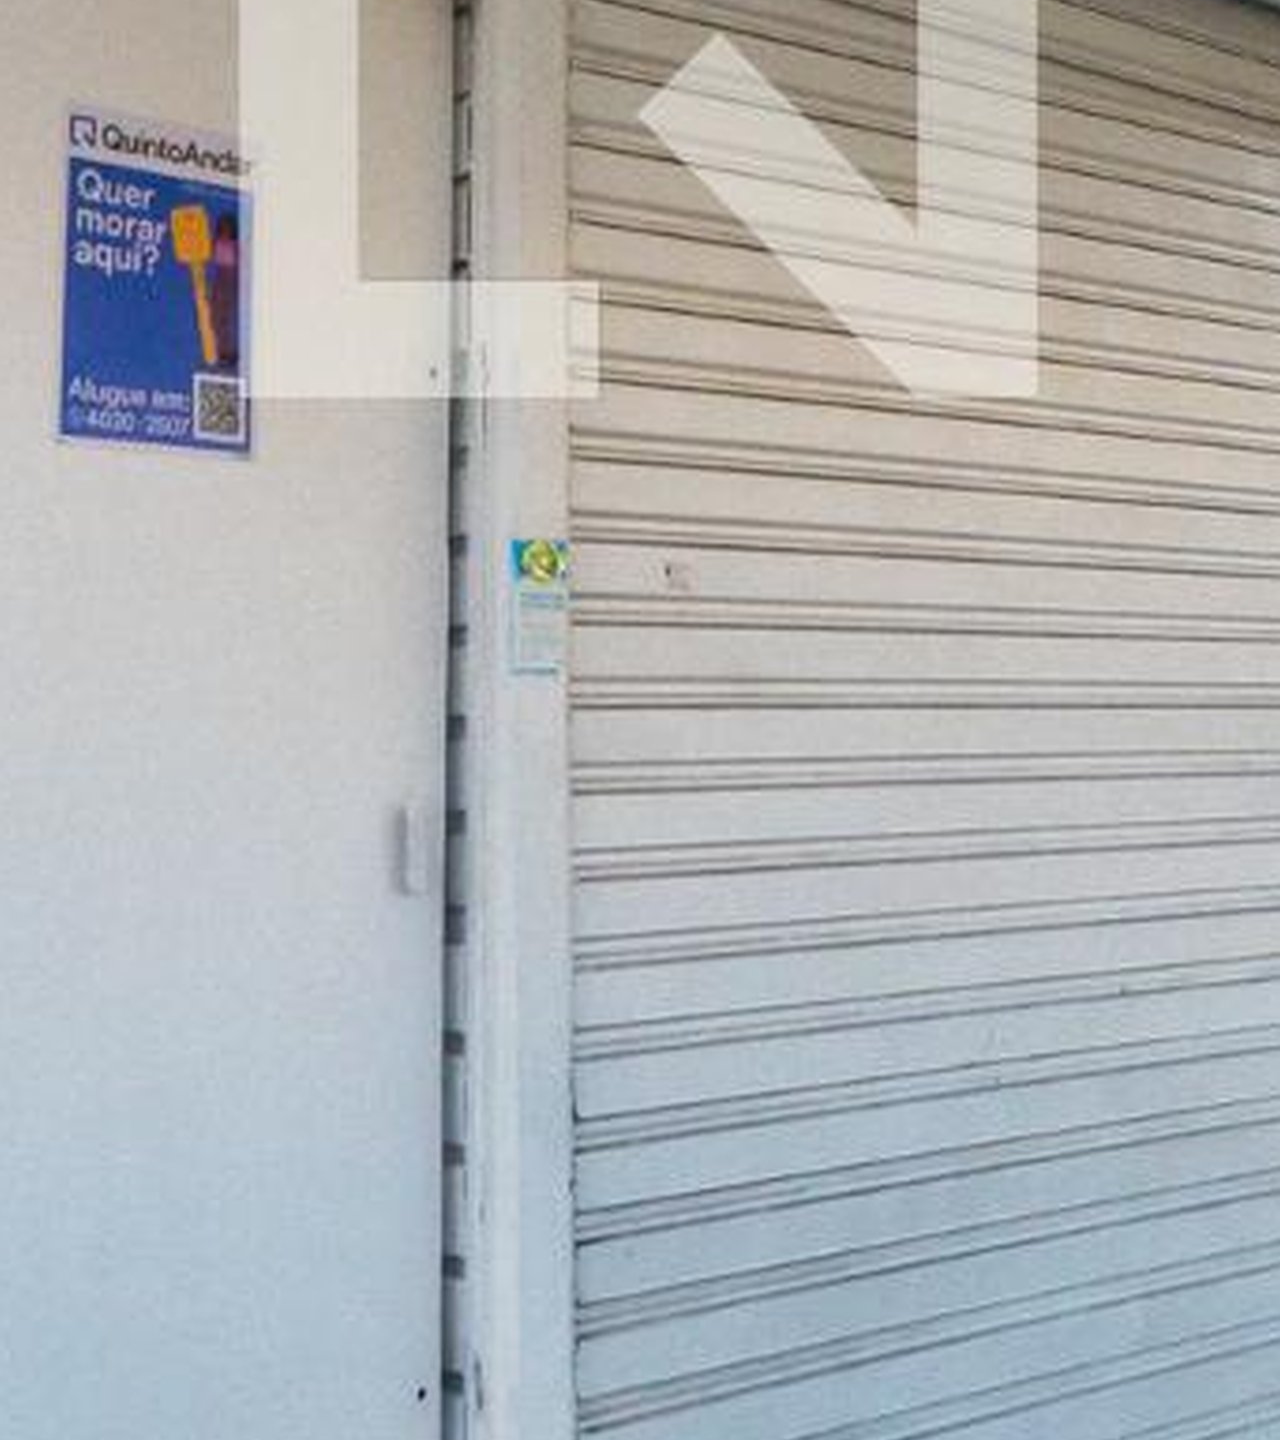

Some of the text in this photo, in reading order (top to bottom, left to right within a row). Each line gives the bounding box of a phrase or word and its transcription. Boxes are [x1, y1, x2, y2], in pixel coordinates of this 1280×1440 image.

[77, 168, 157, 211] Quer
[75, 206, 167, 245] morar
[73, 239, 161, 279] aqui?
